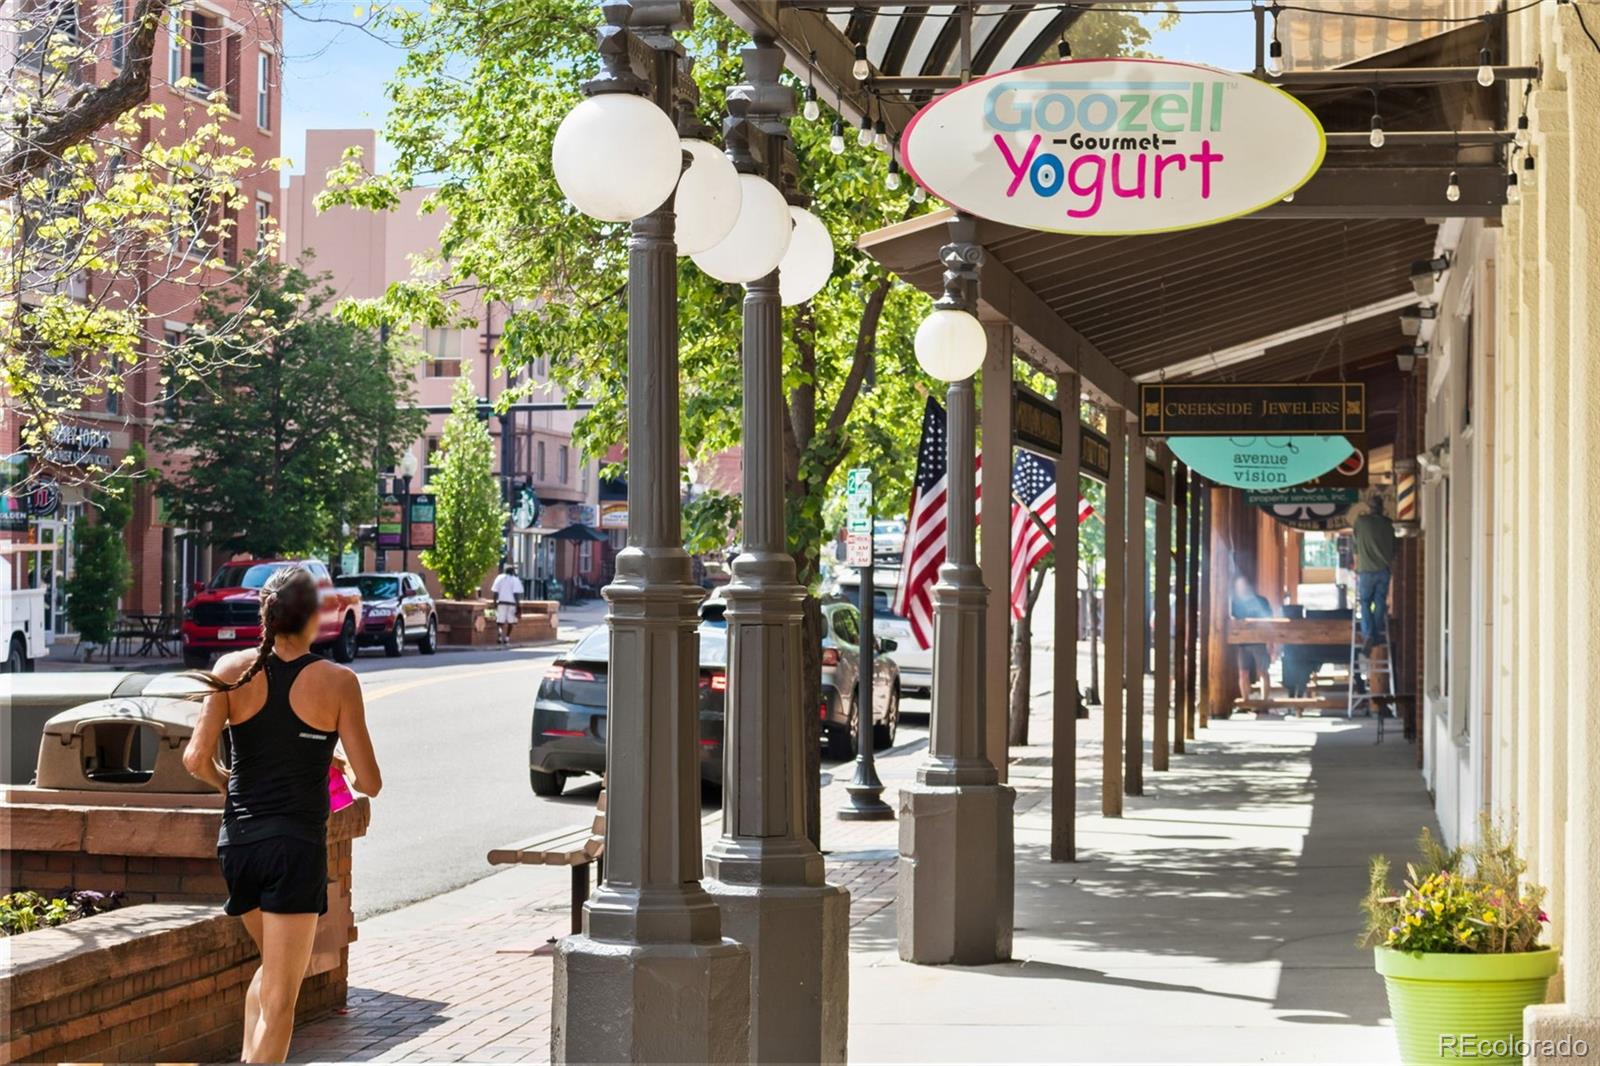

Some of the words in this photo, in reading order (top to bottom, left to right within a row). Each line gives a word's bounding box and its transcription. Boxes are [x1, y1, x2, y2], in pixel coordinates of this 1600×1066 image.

[984, 82, 1224, 132] Goozell
[993, 134, 1224, 218] Yogurt
[1165, 402, 1253, 417] CREEKSIDE
[1261, 400, 1341, 417] JEWELERS
[1233, 453, 1288, 465] avenue
[1233, 468, 1287, 483] vision
[1248, 495, 1288, 503] property
